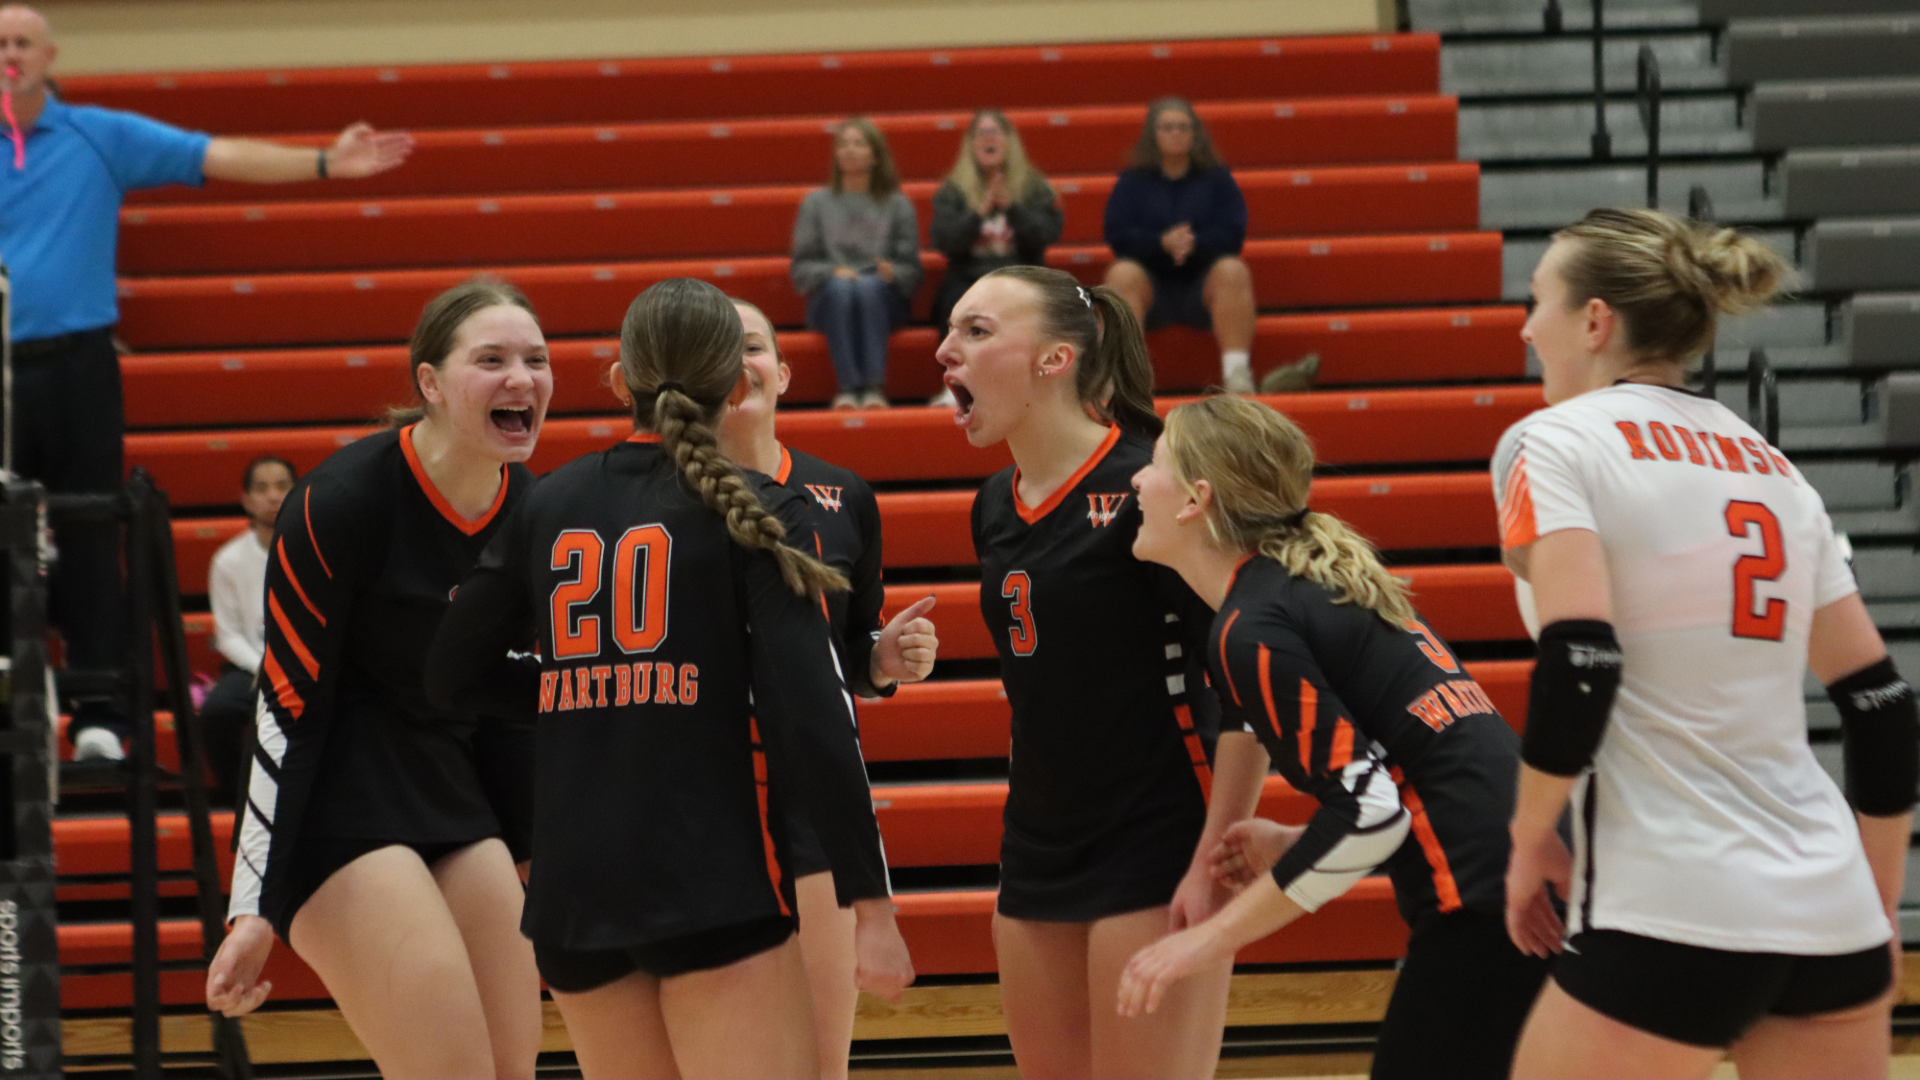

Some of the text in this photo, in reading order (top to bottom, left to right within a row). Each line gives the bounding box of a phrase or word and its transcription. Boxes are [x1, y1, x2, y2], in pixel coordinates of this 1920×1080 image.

[804, 484, 843, 513] W
[1086, 493, 1130, 528] W
[551, 523, 673, 660] 20
[1724, 499, 1787, 642] 2
[1002, 571, 1038, 656] 3
[538, 662, 698, 713] WARTBURG
[0, 899, 26, 1070] sports imports
